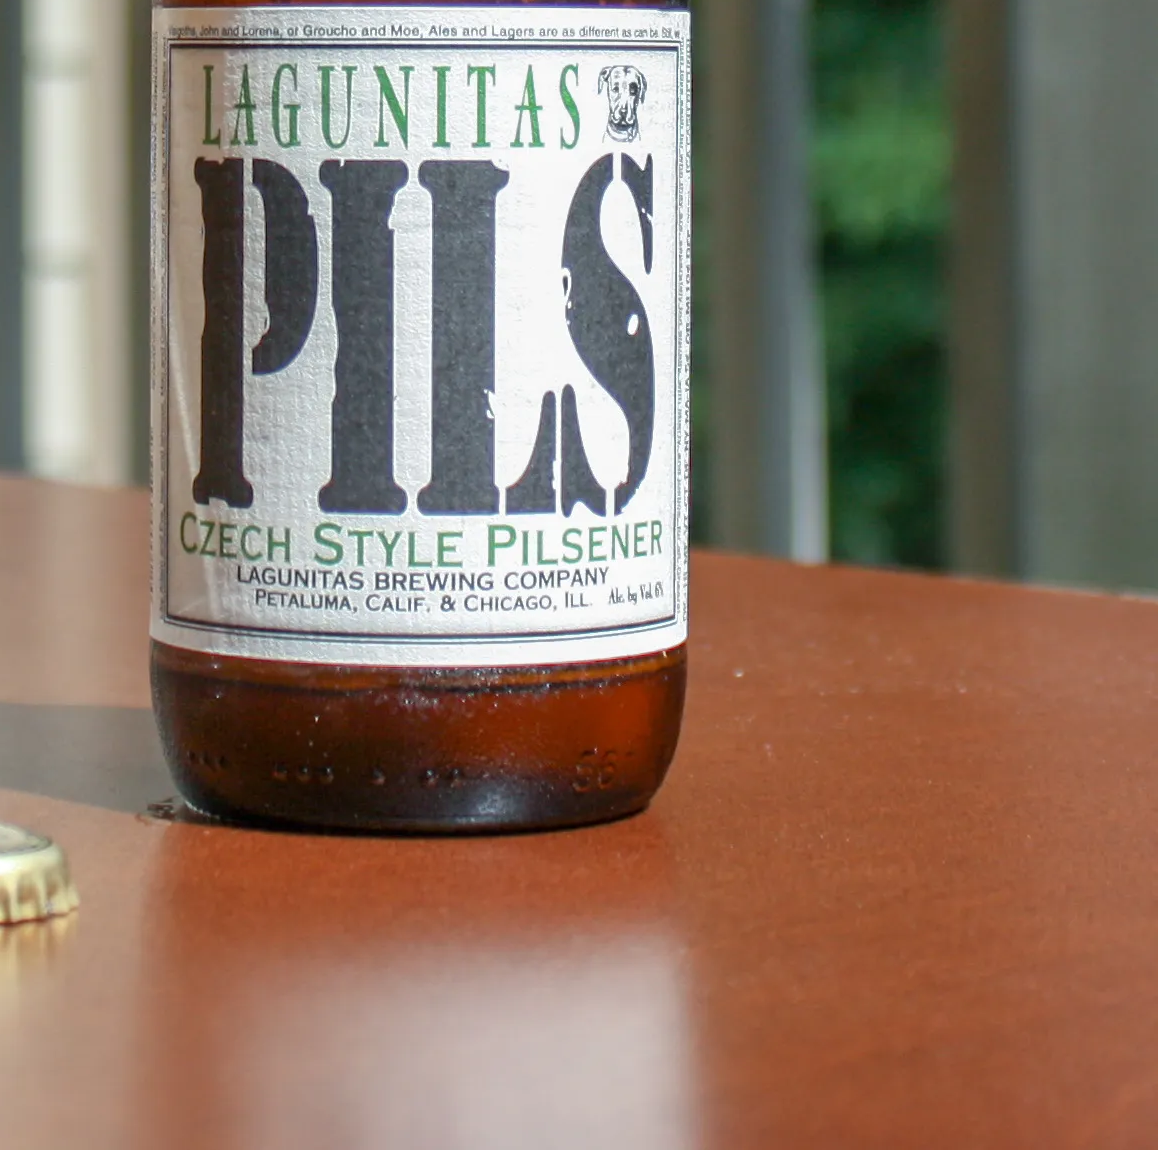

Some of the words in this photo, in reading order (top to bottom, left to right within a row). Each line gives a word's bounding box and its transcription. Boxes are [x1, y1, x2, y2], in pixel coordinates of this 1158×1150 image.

[222, 26, 239, 37] and
[242, 25, 283, 39] Lorena,
[286, 26, 299, 37] or
[303, 24, 357, 38] Groucho
[361, 25, 386, 37] and
[390, 24, 424, 39] Moe,
[428, 24, 458, 37] Ales
[462, 25, 487, 38] and
[491, 25, 535, 40] Lagers
[539, 27, 559, 38] are
[561, 27, 576, 38] as
[579, 26, 620, 38] different
[622, 28, 632, 38] as
[633, 28, 648, 38] can
[201, 63, 581, 150] LAGUNITAS
[193, 152, 655, 518] PILS
[179, 510, 292, 562] CZECH
[313, 522, 464, 569] STYLE
[487, 519, 664, 569] PILSENER
[236, 564, 365, 592] LAGUNITAS
[374, 570, 495, 594] BREWING
[503, 566, 610, 592] COMPANY
[254, 587, 358, 614] PETALUMA,
[365, 594, 432, 614] CALIF.
[439, 595, 457, 612] &
[462, 593, 558, 613] CHICAGO,
[564, 591, 593, 609] ILL.
[627, 585, 638, 606] by
